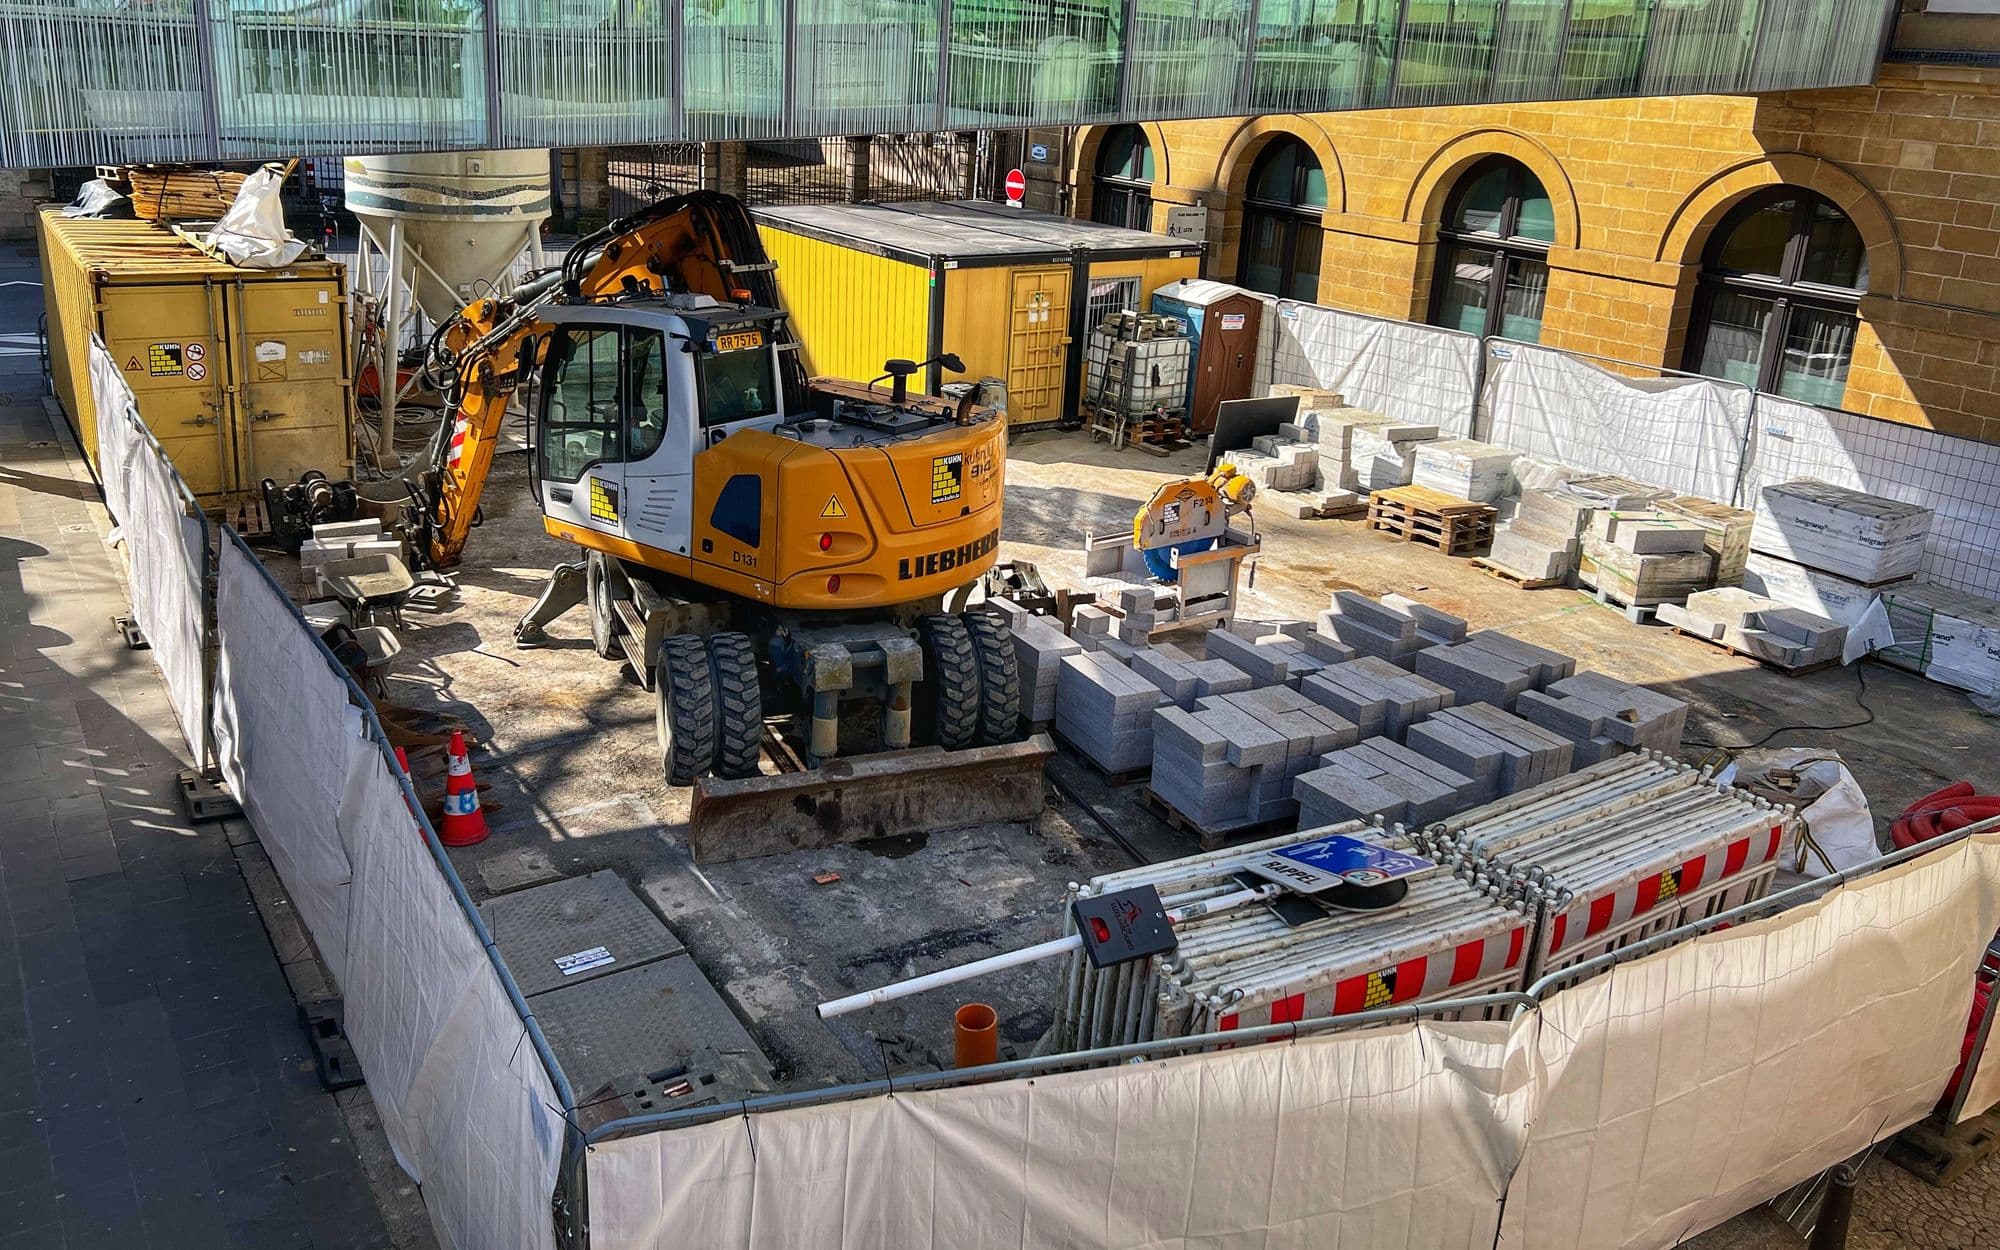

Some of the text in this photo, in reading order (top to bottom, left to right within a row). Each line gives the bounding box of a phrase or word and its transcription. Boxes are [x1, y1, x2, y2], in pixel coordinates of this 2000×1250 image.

[721, 333, 758, 349] RR 7576
[943, 454, 962, 465] KUHN
[600, 480, 618, 491] KUHN
[899, 528, 998, 580] LIEBHERR
[1262, 860, 1321, 885] RAPPEL
[1350, 871, 1379, 882] 20
[1378, 965, 1397, 978] KUHN
